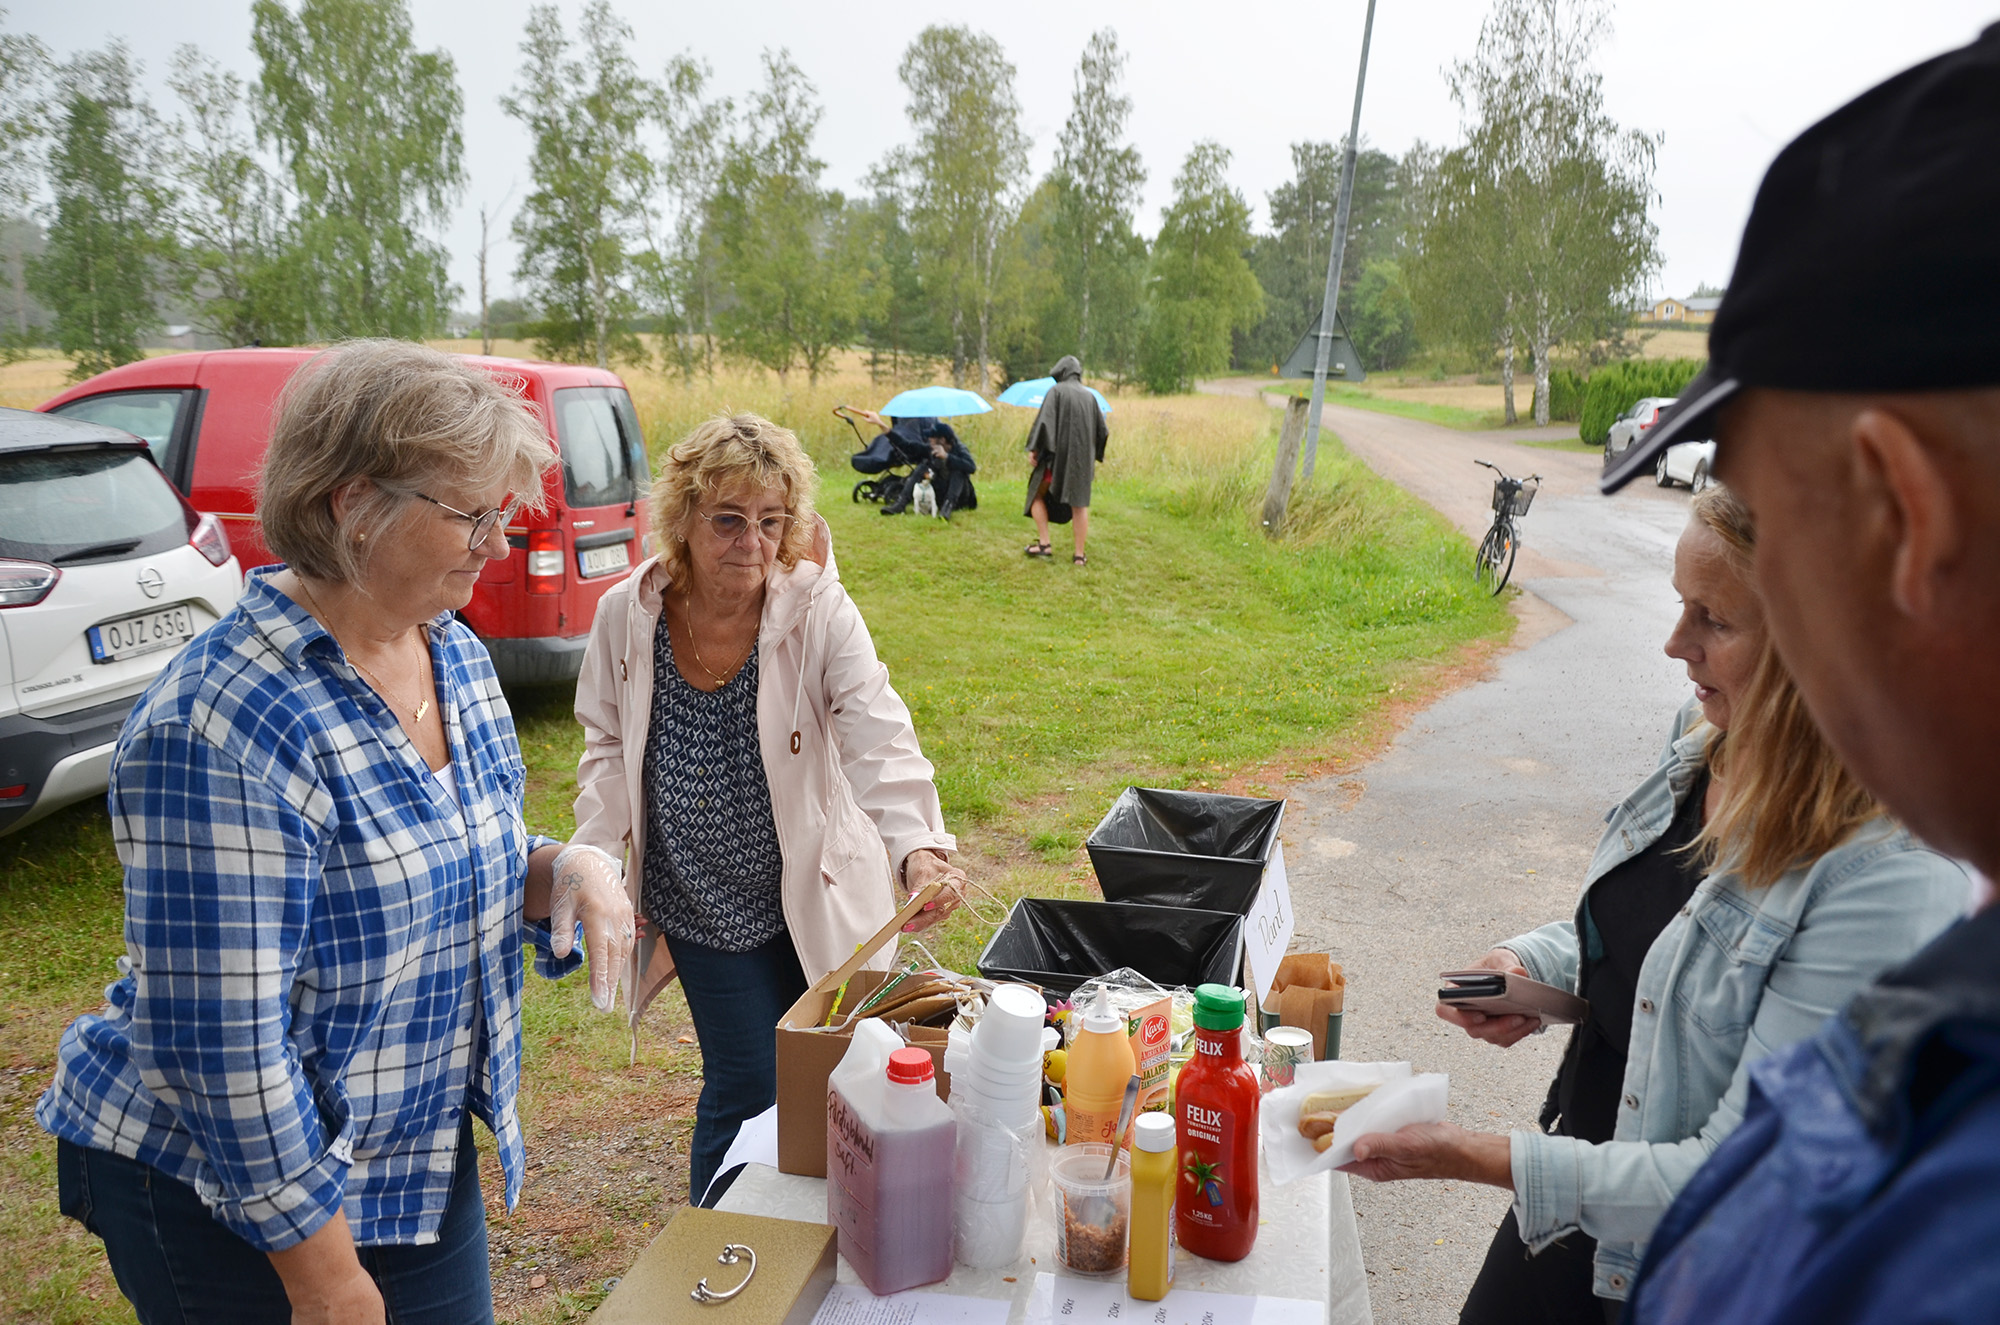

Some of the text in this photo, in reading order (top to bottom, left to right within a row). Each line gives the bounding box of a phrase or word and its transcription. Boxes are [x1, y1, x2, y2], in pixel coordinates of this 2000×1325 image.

[109, 620, 148, 650] OJZ
[152, 611, 185, 639] 63G
[1258, 889, 1284, 954] Pant
[1144, 1018, 1166, 1043] Kavli
[1196, 1037, 1223, 1057] FELIX
[1187, 1104, 1222, 1128] FELIX
[1187, 1128, 1221, 1144] ORIGINAL
[1061, 1298, 1075, 1315] 60kr
[1107, 1302, 1121, 1318] 20kr
[1154, 1307, 1167, 1324] 20kr
